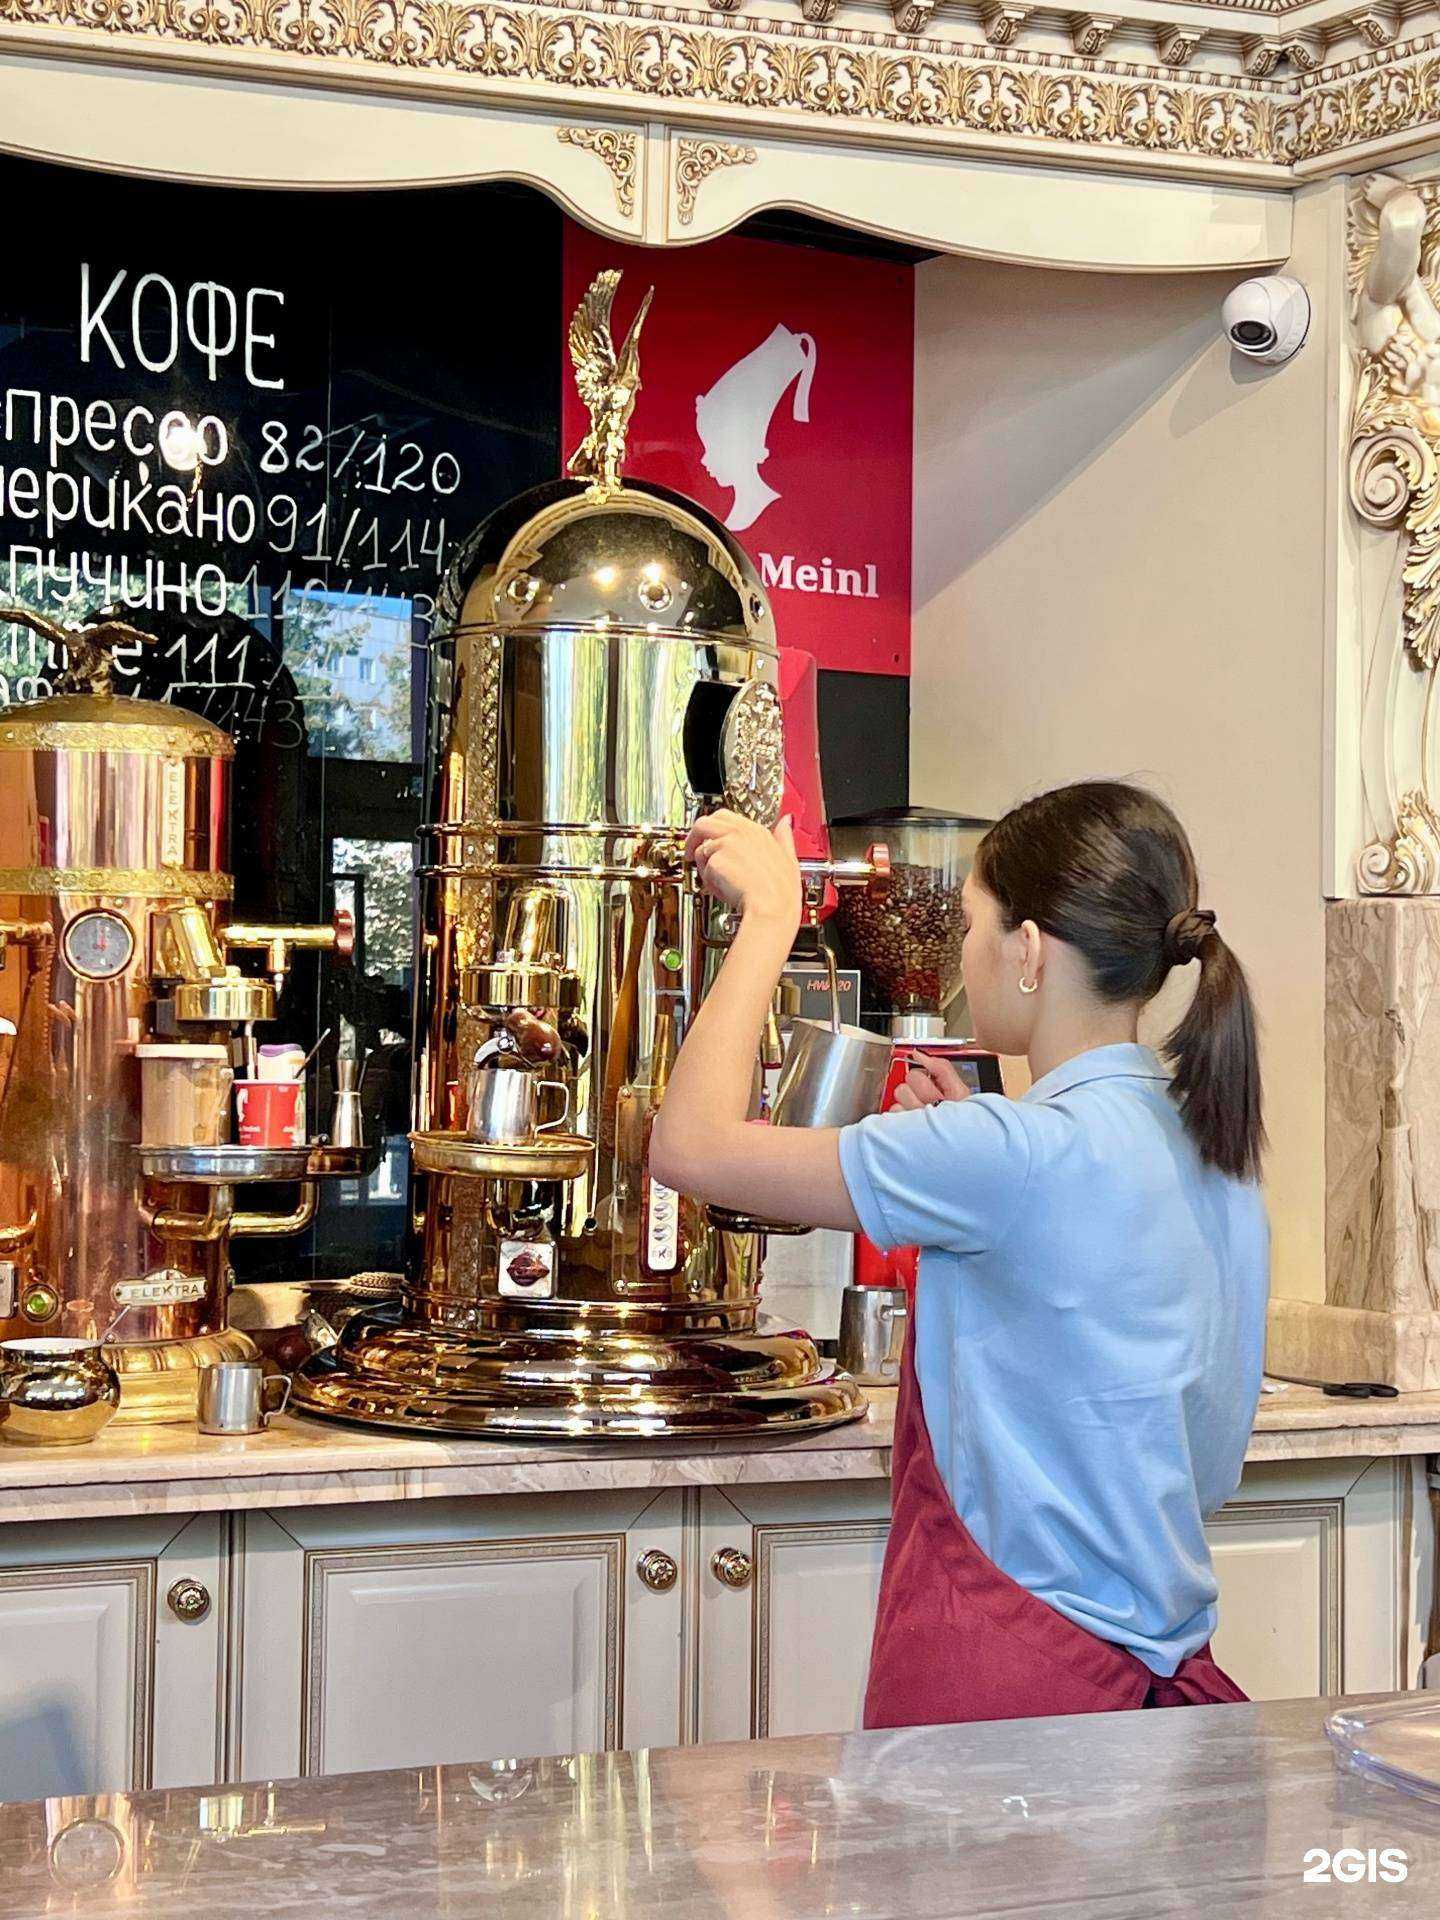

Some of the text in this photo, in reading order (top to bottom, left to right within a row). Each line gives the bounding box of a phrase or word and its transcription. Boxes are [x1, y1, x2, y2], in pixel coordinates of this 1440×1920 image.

[81, 262, 285, 390] КОФЕ
[0, 387, 461, 494] прессо 82/120
[0, 465, 445, 575] ерикано 91/114
[0, 544, 228, 617] пучино
[758, 552, 879, 598] Meinl
[168, 771, 179, 856] ELEKTRA
[131, 1284, 199, 1298] ELEKTRA
